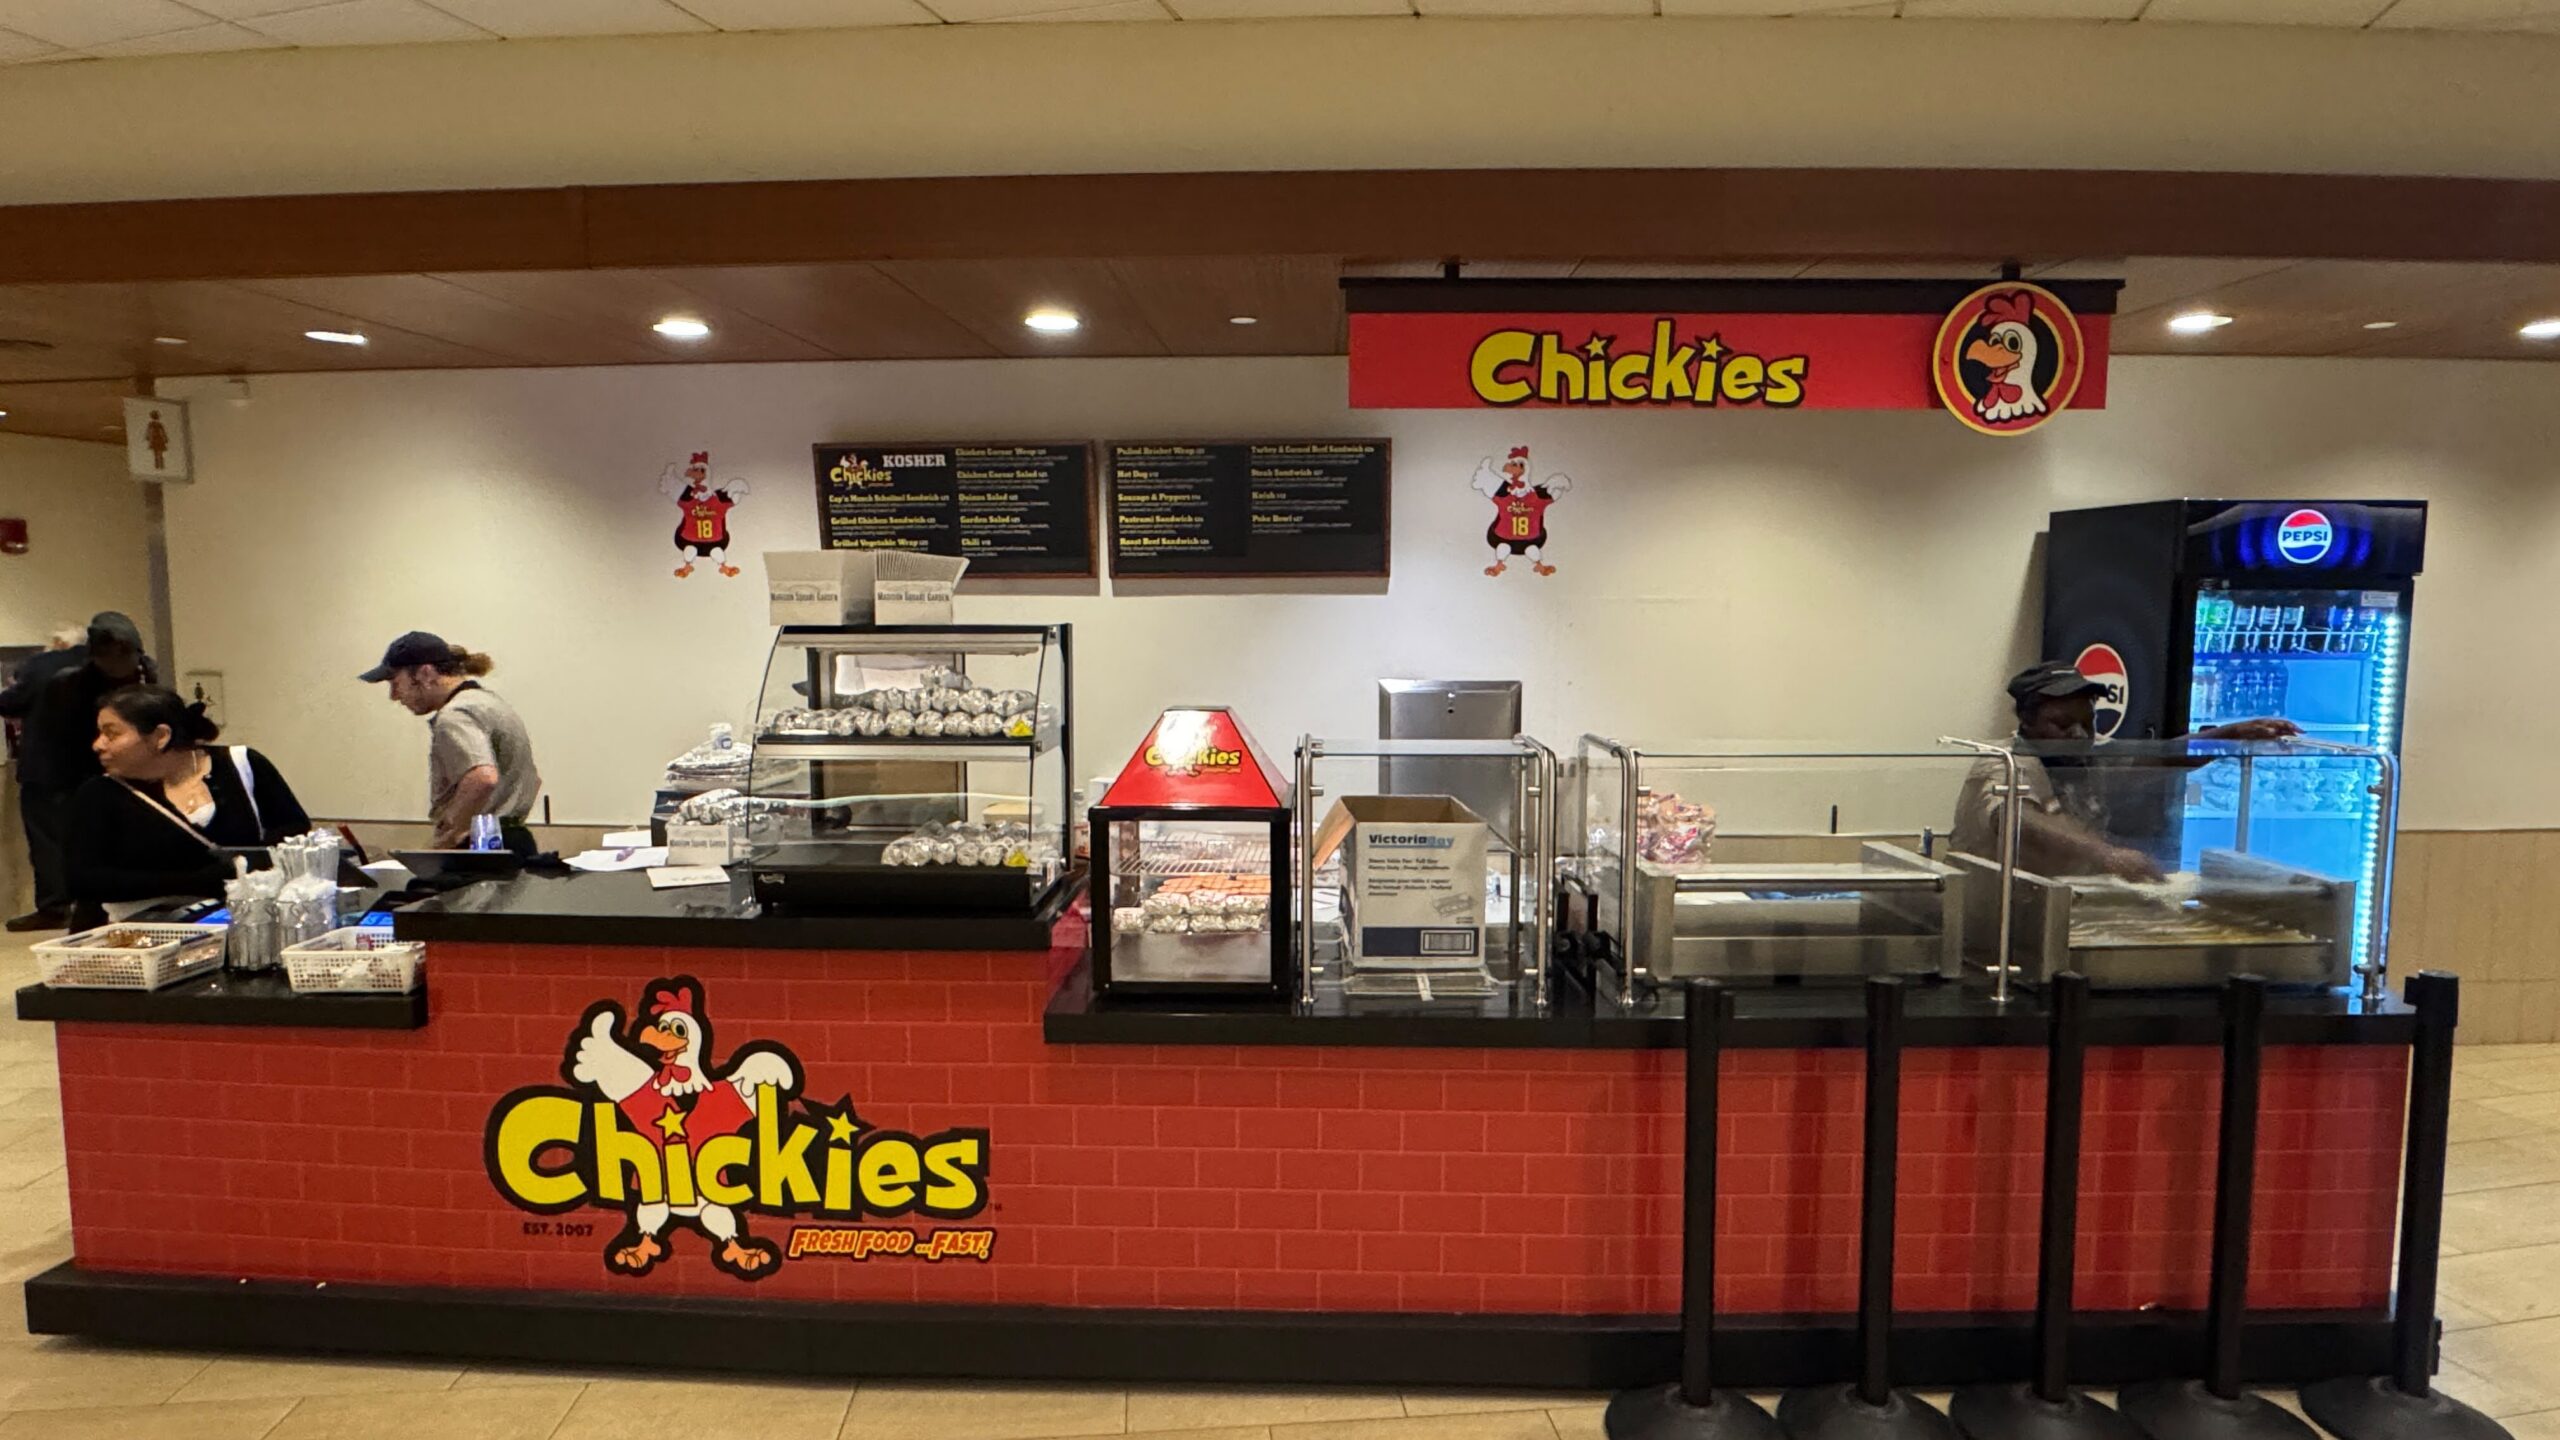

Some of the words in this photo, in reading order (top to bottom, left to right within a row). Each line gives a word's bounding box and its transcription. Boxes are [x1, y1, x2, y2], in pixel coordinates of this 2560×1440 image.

[1470, 318, 1808, 407] Chickies
[1329, 445, 1364, 453] Sandwich
[882, 454, 946, 467] KOSHER
[830, 466, 892, 482] Chickies
[1015, 470, 1038, 478] Salad
[1117, 470, 1132, 478] Hot
[1132, 470, 1148, 479] Dog
[1274, 468, 1313, 476] Sandwich
[906, 493, 939, 501] Sandwich
[986, 493, 1008, 501] Salad
[1251, 491, 1275, 499] Knish
[831, 517, 857, 525] Grilled
[1119, 515, 1155, 523] Pastrami
[1155, 515, 1193, 523] Sandwich
[696, 519, 713, 539] 18
[1511, 516, 1529, 536] 18
[2281, 530, 2329, 542] PEPSI
[832, 539, 859, 547] Grilled
[859, 539, 897, 547] Vegetable
[897, 539, 919, 547] Wrap
[961, 538, 980, 546] Chili
[1120, 537, 1141, 545] Roast
[1142, 537, 1160, 545] Beef
[1161, 537, 1199, 545] Sandwich
[494, 1079, 983, 1214] Chickies
[522, 1222, 553, 1236] EST.
[555, 1222, 594, 1237] 2007
[854, 1229, 915, 1259] FOOD
